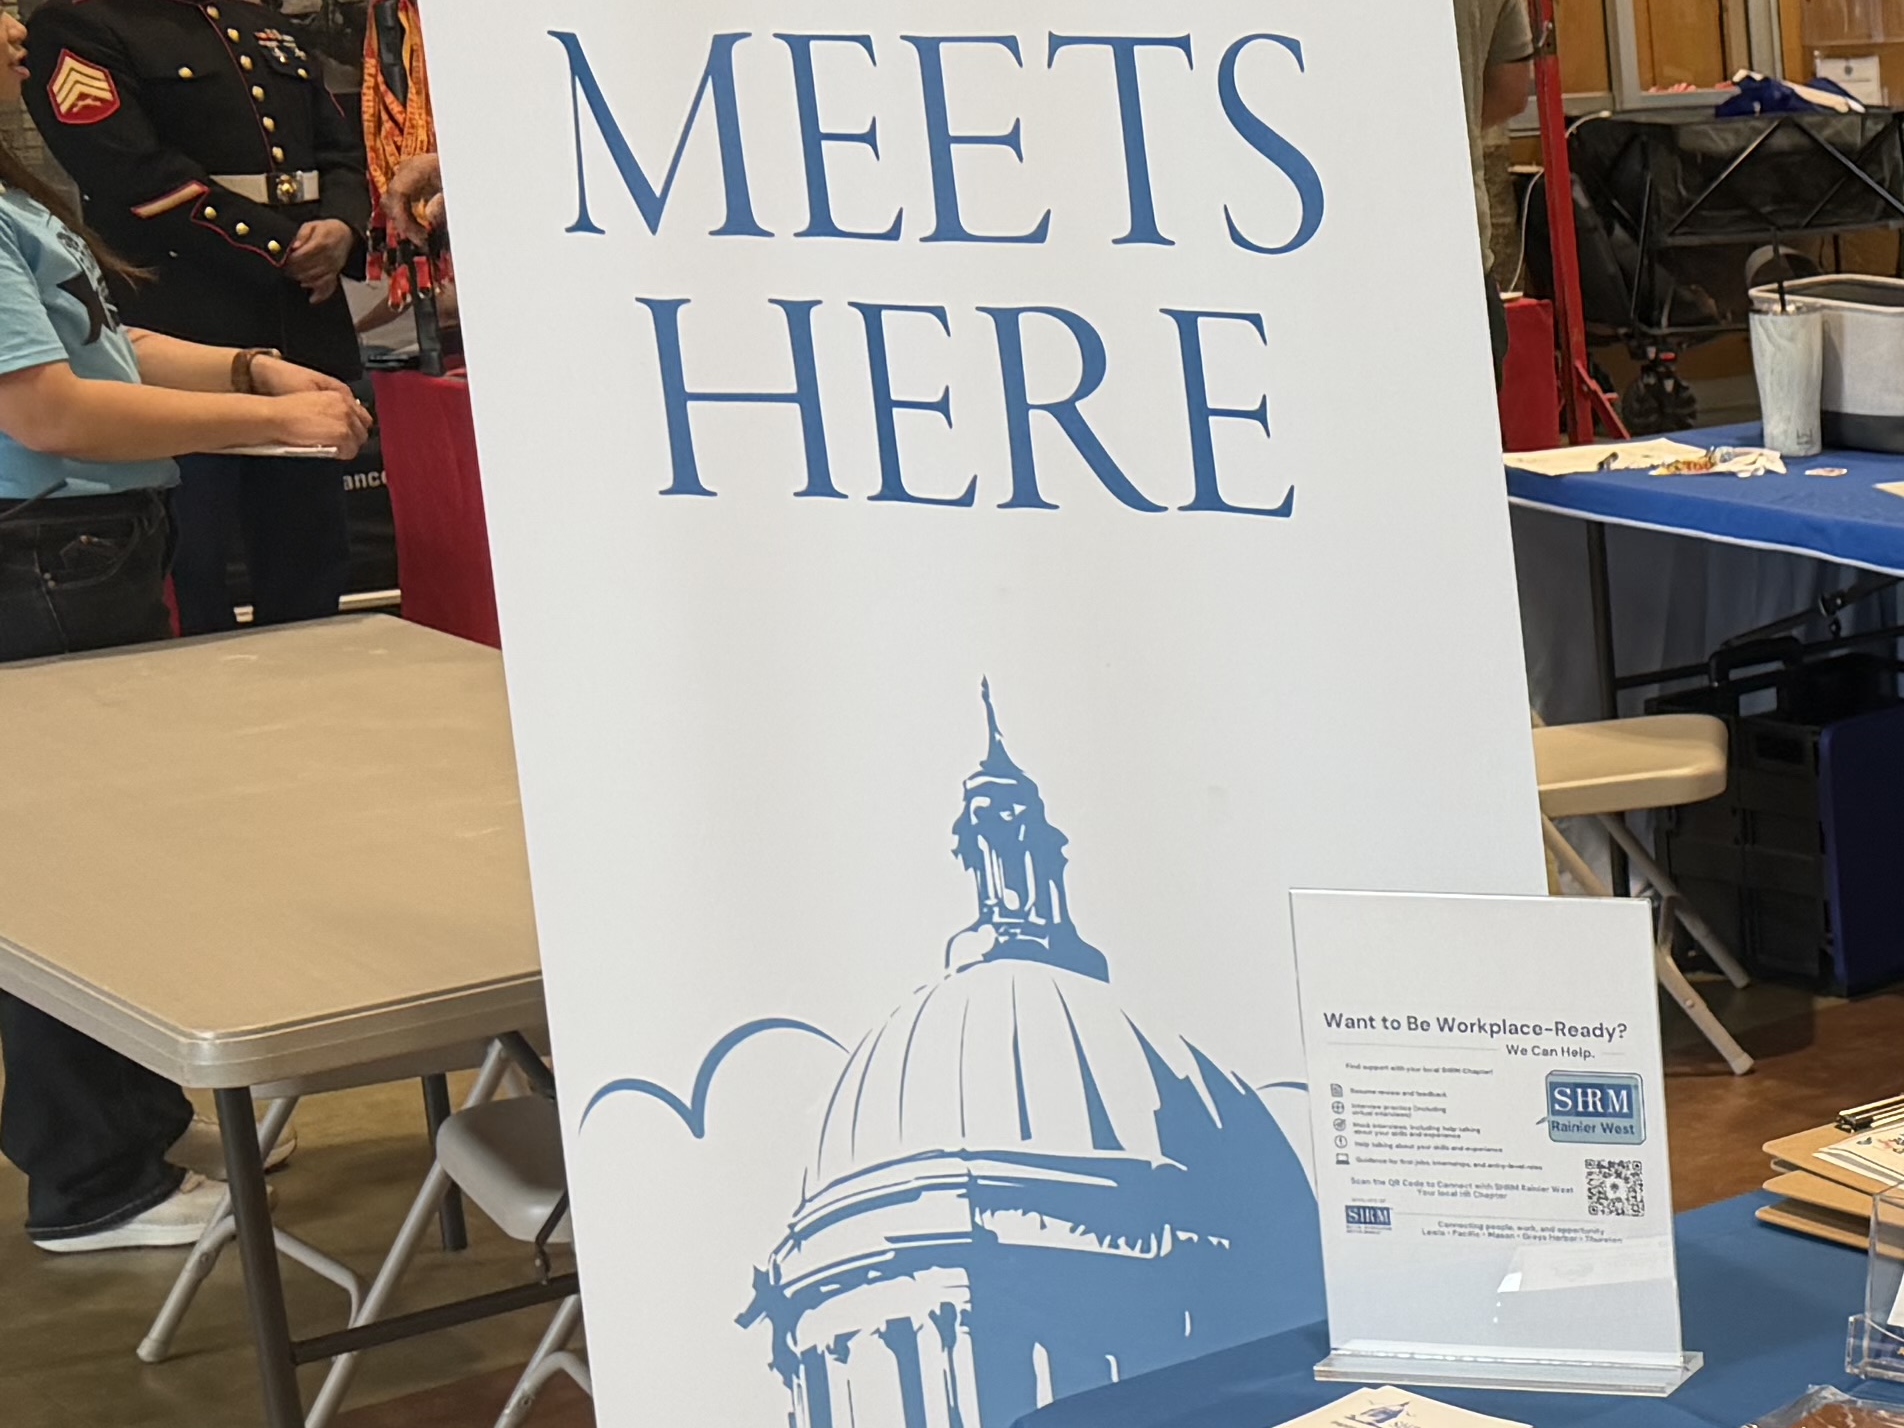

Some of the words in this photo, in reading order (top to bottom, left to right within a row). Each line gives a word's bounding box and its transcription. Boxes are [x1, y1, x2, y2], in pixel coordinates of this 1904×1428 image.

[546, 30, 1325, 255] MEETS
[634, 297, 1296, 519] HERE
[1323, 1012, 1375, 1030] Want
[1382, 1016, 1401, 1031] to
[1407, 1015, 1431, 1032] Be
[1437, 1017, 1628, 1043] Workplace-Ready?
[1506, 1044, 1527, 1056] We
[1532, 1045, 1558, 1057] Can
[1561, 1046, 1595, 1061] Help.
[1553, 1087, 1630, 1114] SHRM
[1551, 1119, 1596, 1134] Rainier
[1600, 1122, 1635, 1136] West
